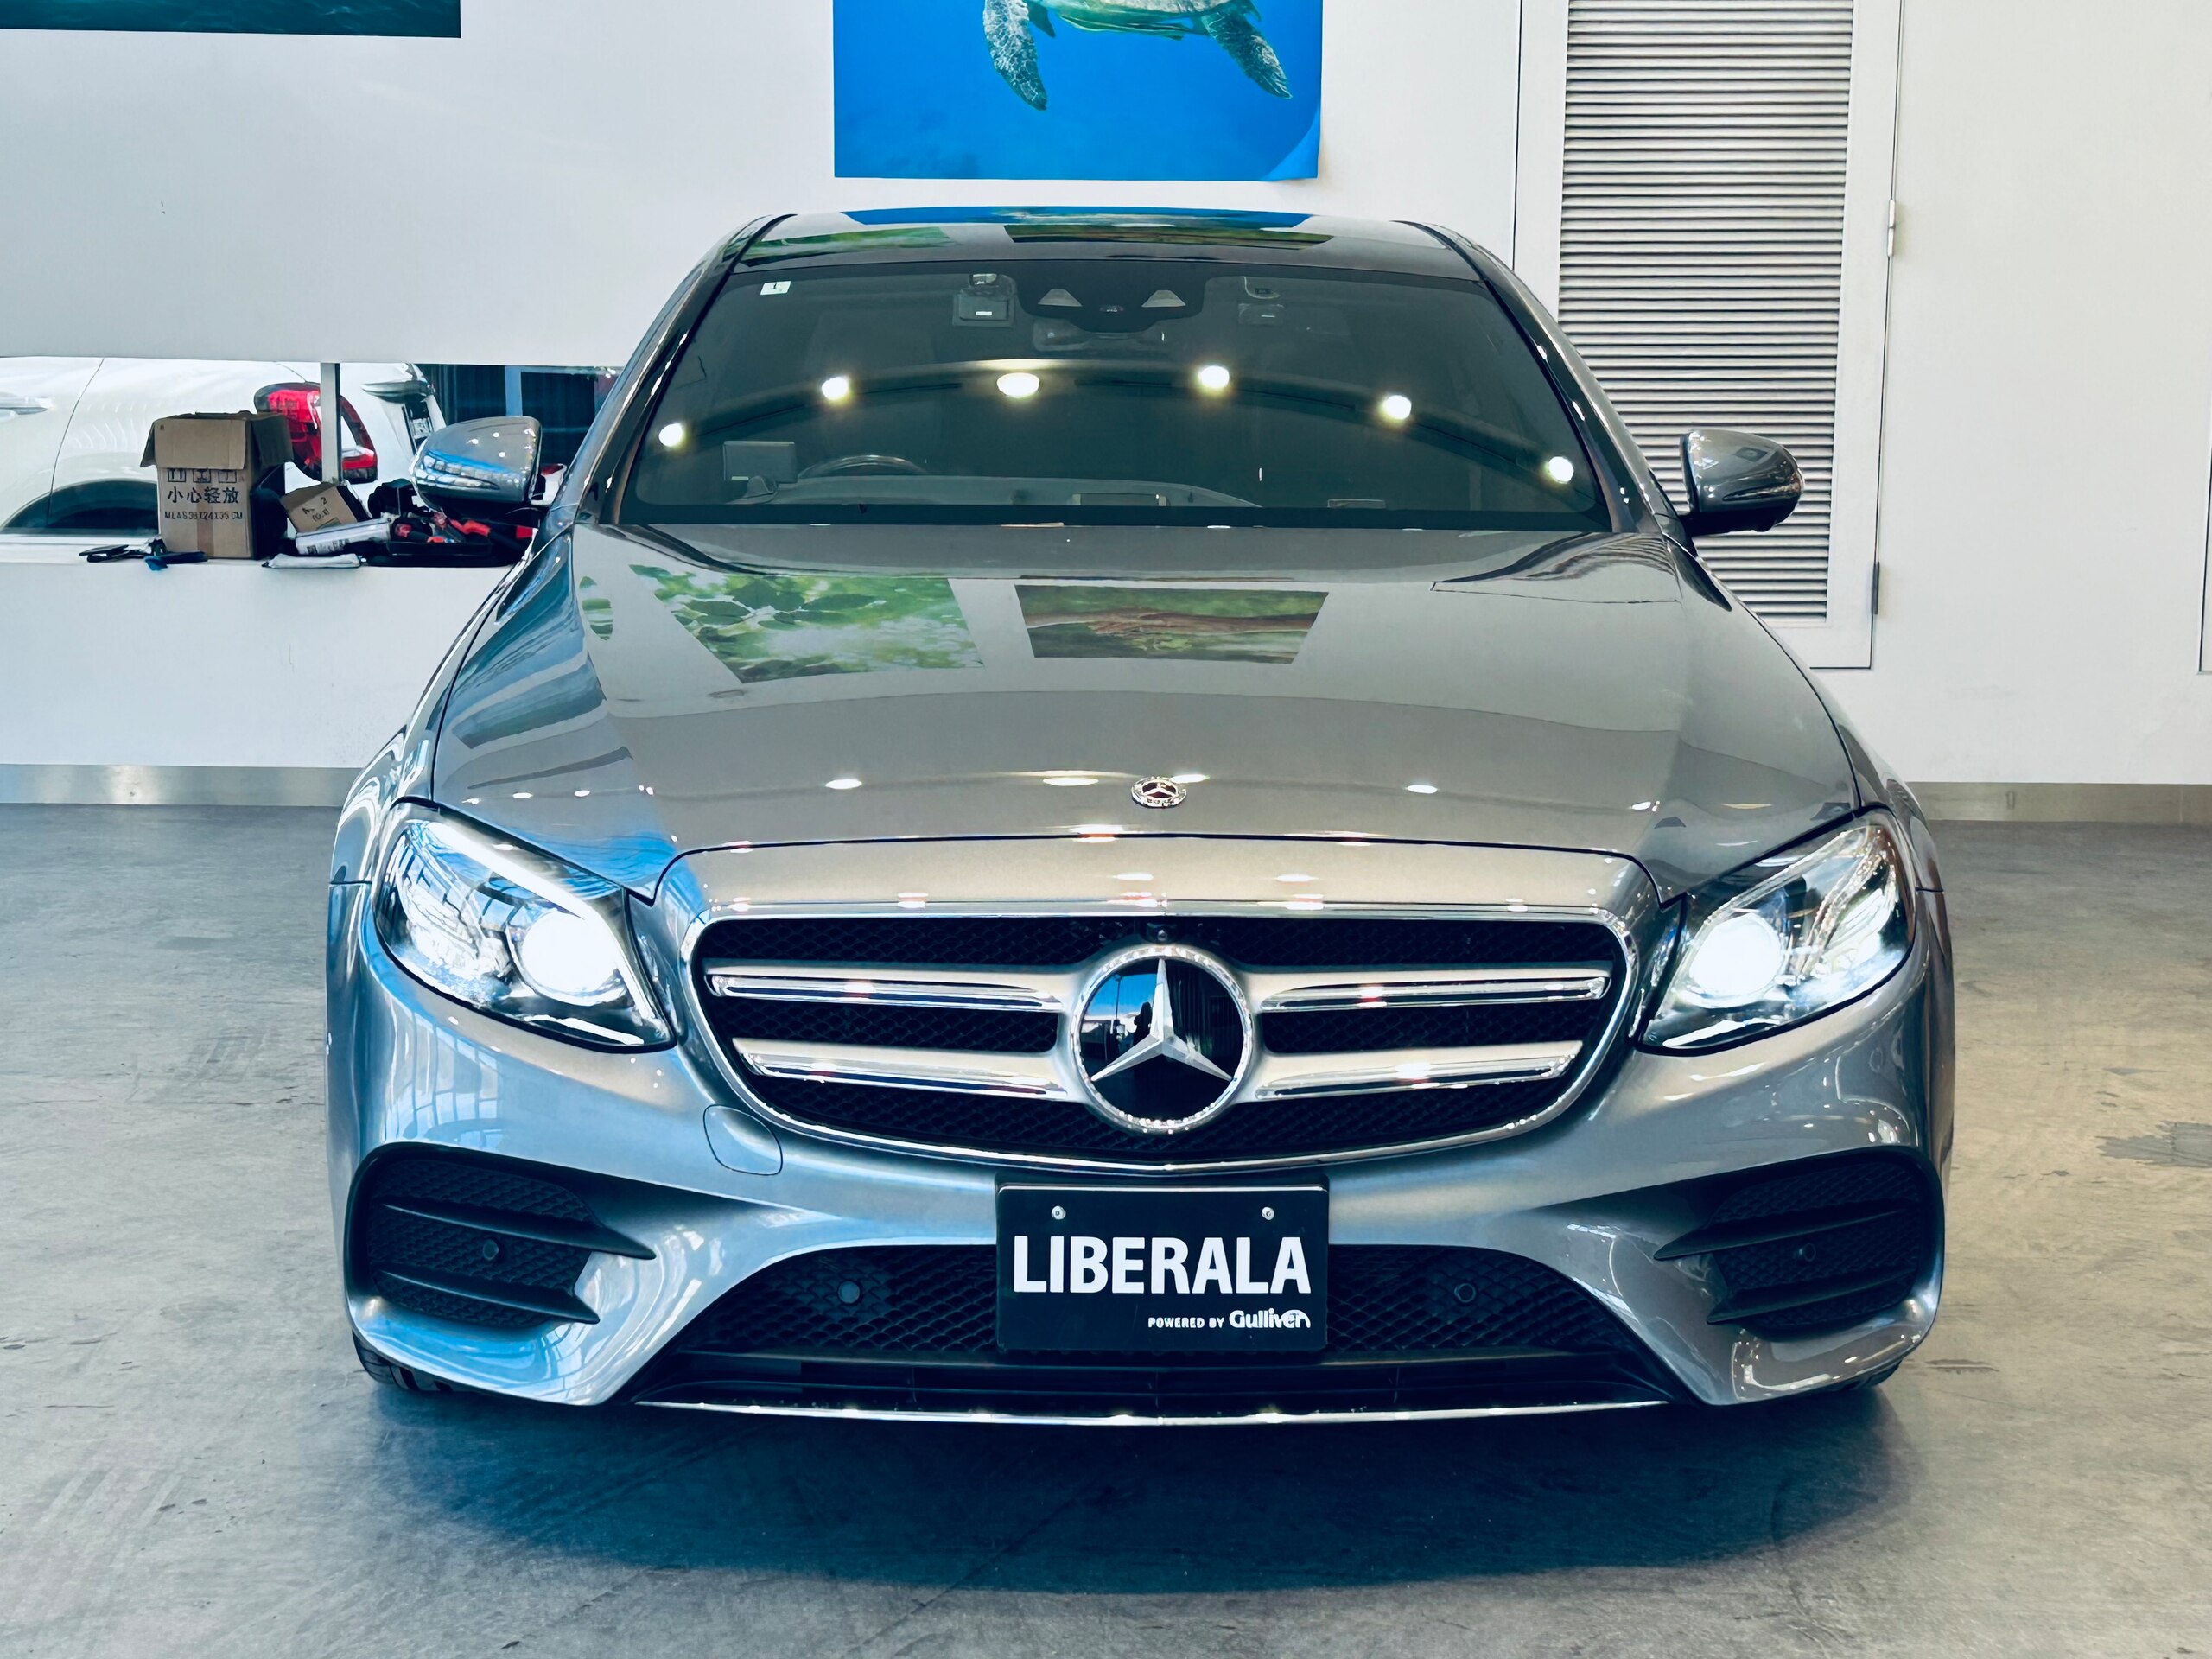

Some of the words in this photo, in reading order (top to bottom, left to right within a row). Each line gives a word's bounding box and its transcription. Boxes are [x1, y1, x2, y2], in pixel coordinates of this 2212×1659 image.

[167, 486, 239, 504] 小心轻放
[1014, 1236, 1312, 1294] LIBERALA
[1147, 1317, 1205, 1329] POWERED
[1209, 1317, 1225, 1329] BY
[1228, 1307, 1312, 1329] Gulliver
